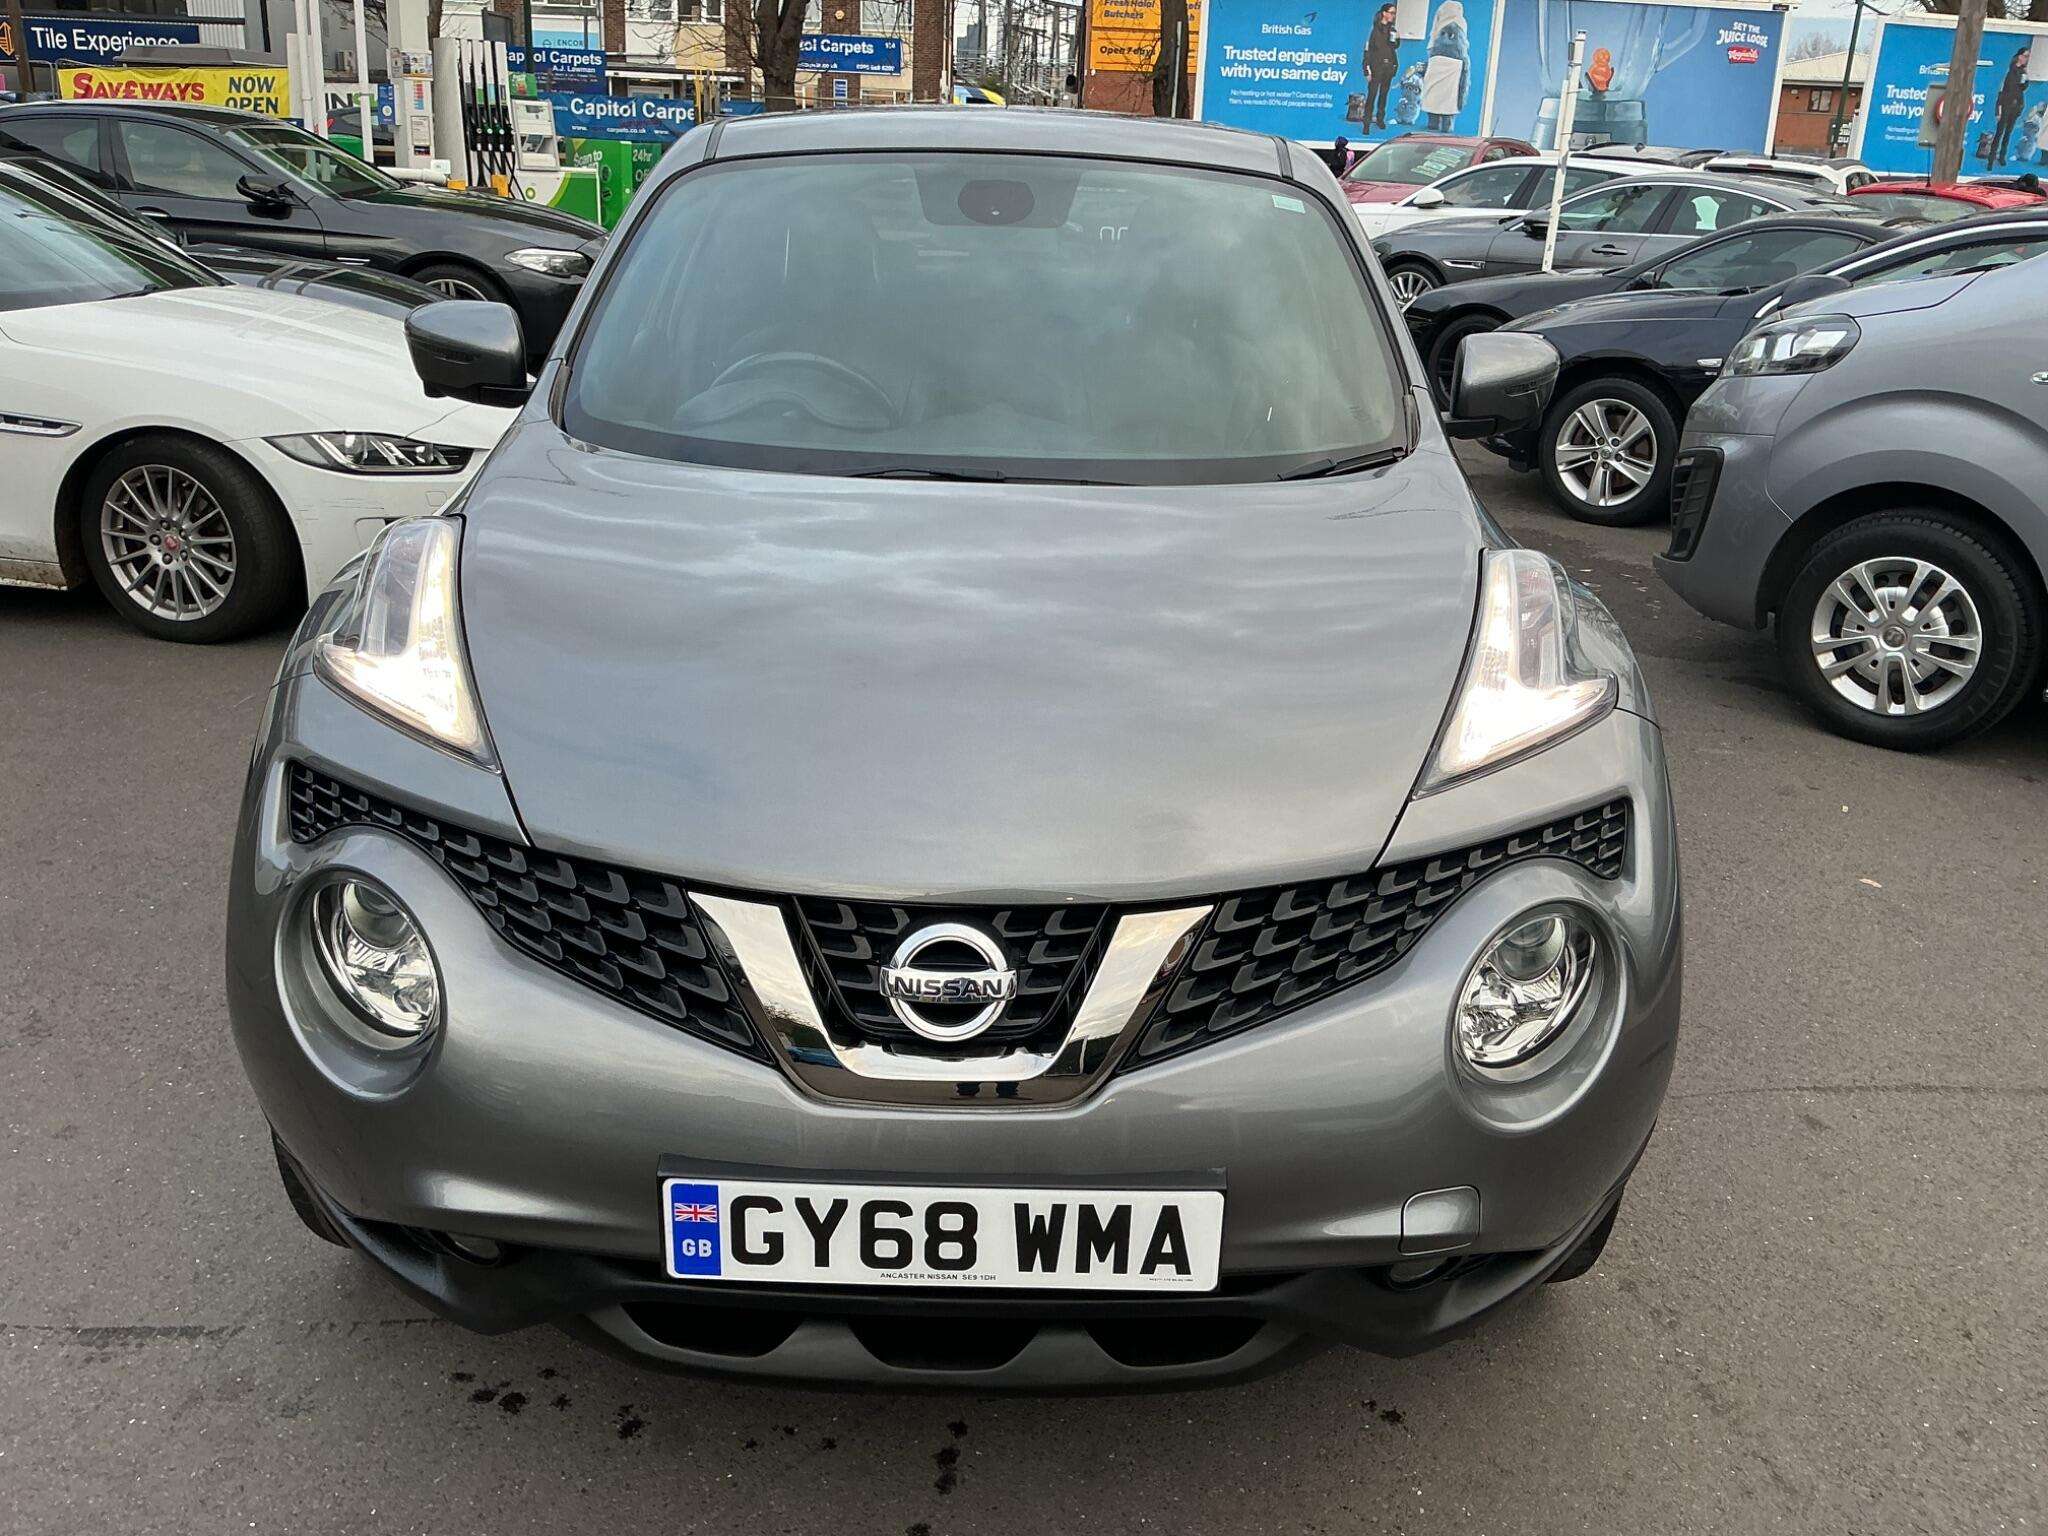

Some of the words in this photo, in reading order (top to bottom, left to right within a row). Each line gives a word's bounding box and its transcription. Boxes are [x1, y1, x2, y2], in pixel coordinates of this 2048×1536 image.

[1262, 23, 1292, 35] British
[1294, 25, 1312, 35] Gas
[1732, 21, 1747, 32] SET
[1748, 24, 1760, 34] THE
[31, 27, 67, 49] Tile
[1716, 28, 1746, 45] JUICE
[1746, 33, 1768, 48] LOOSE
[820, 39, 874, 56] Carpets
[1100, 45, 1125, 55] Open
[1223, 45, 1277, 62] Trusted
[1278, 48, 1347, 66] engineers
[550, 51, 602, 66] Carpets
[1220, 63, 1252, 78] with
[1254, 67, 1280, 82] you
[1281, 68, 1320, 81] same
[1321, 67, 1348, 85] day
[228, 76, 276, 94] NOW
[1886, 84, 1928, 100] Trusted
[225, 97, 279, 114] OPEN
[570, 98, 636, 120] Capitol
[642, 101, 695, 124] Carpe
[1882, 102, 1907, 115] with
[632, 148, 652, 162] 24hr
[894, 976, 1003, 997] NISSAN
[729, 1195, 978, 1271] GY68
[1013, 1203, 1193, 1275] WMA
[682, 1238, 712, 1258] GB
[880, 1272, 925, 1280] ANCASTER
[927, 1273, 958, 1281] NISSAN
